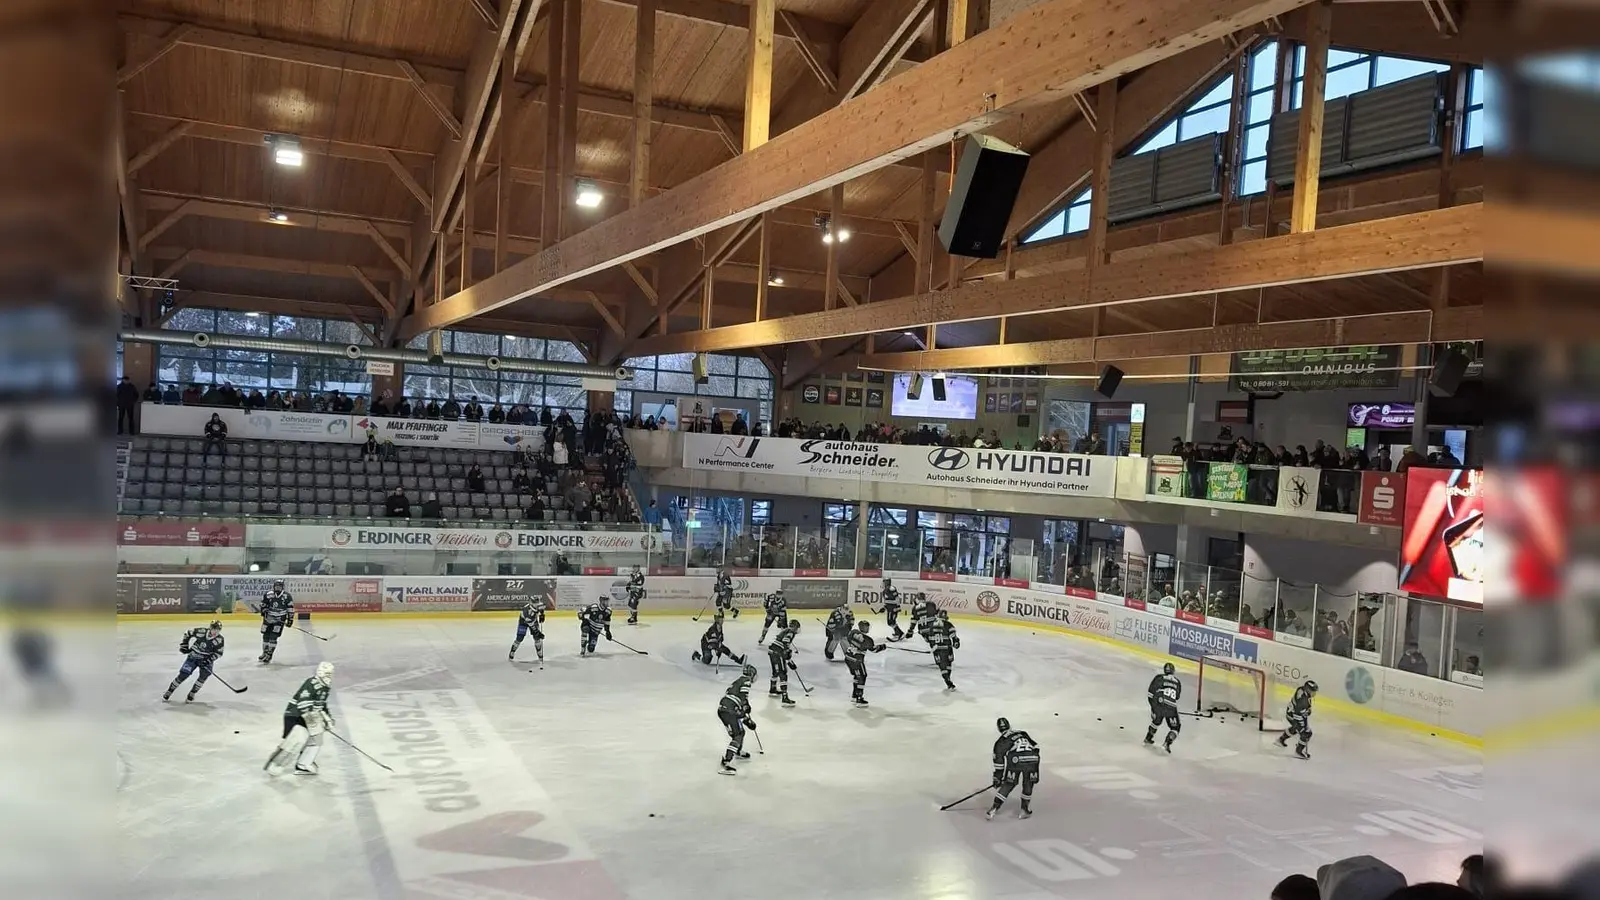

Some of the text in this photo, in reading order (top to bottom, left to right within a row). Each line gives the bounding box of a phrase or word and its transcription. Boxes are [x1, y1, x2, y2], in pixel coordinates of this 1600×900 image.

[1302, 363, 1376, 375] OMNIBUS
[386, 421, 404, 431] MAX
[405, 422, 448, 433] PFAFFINGER
[825, 441, 879, 452] autohaus
[706, 458, 749, 468] Performance
[751, 461, 774, 470] Center
[976, 452, 1091, 477] HYUNDAI
[927, 473, 1089, 491] Autohaus Schneider ihr Hyundai Partner
[358, 530, 488, 546] ERDINGER Weißbier
[518, 533, 634, 548] ERDINGER Weißbier
[406, 587, 468, 595] KARL KAINZ
[1007, 600, 1111, 631] ERDINGER Weißbier
[1134, 619, 1170, 637] FLIESEN
[1133, 631, 1158, 645] AUER
[1171, 625, 1231, 652] MOSBAUER
